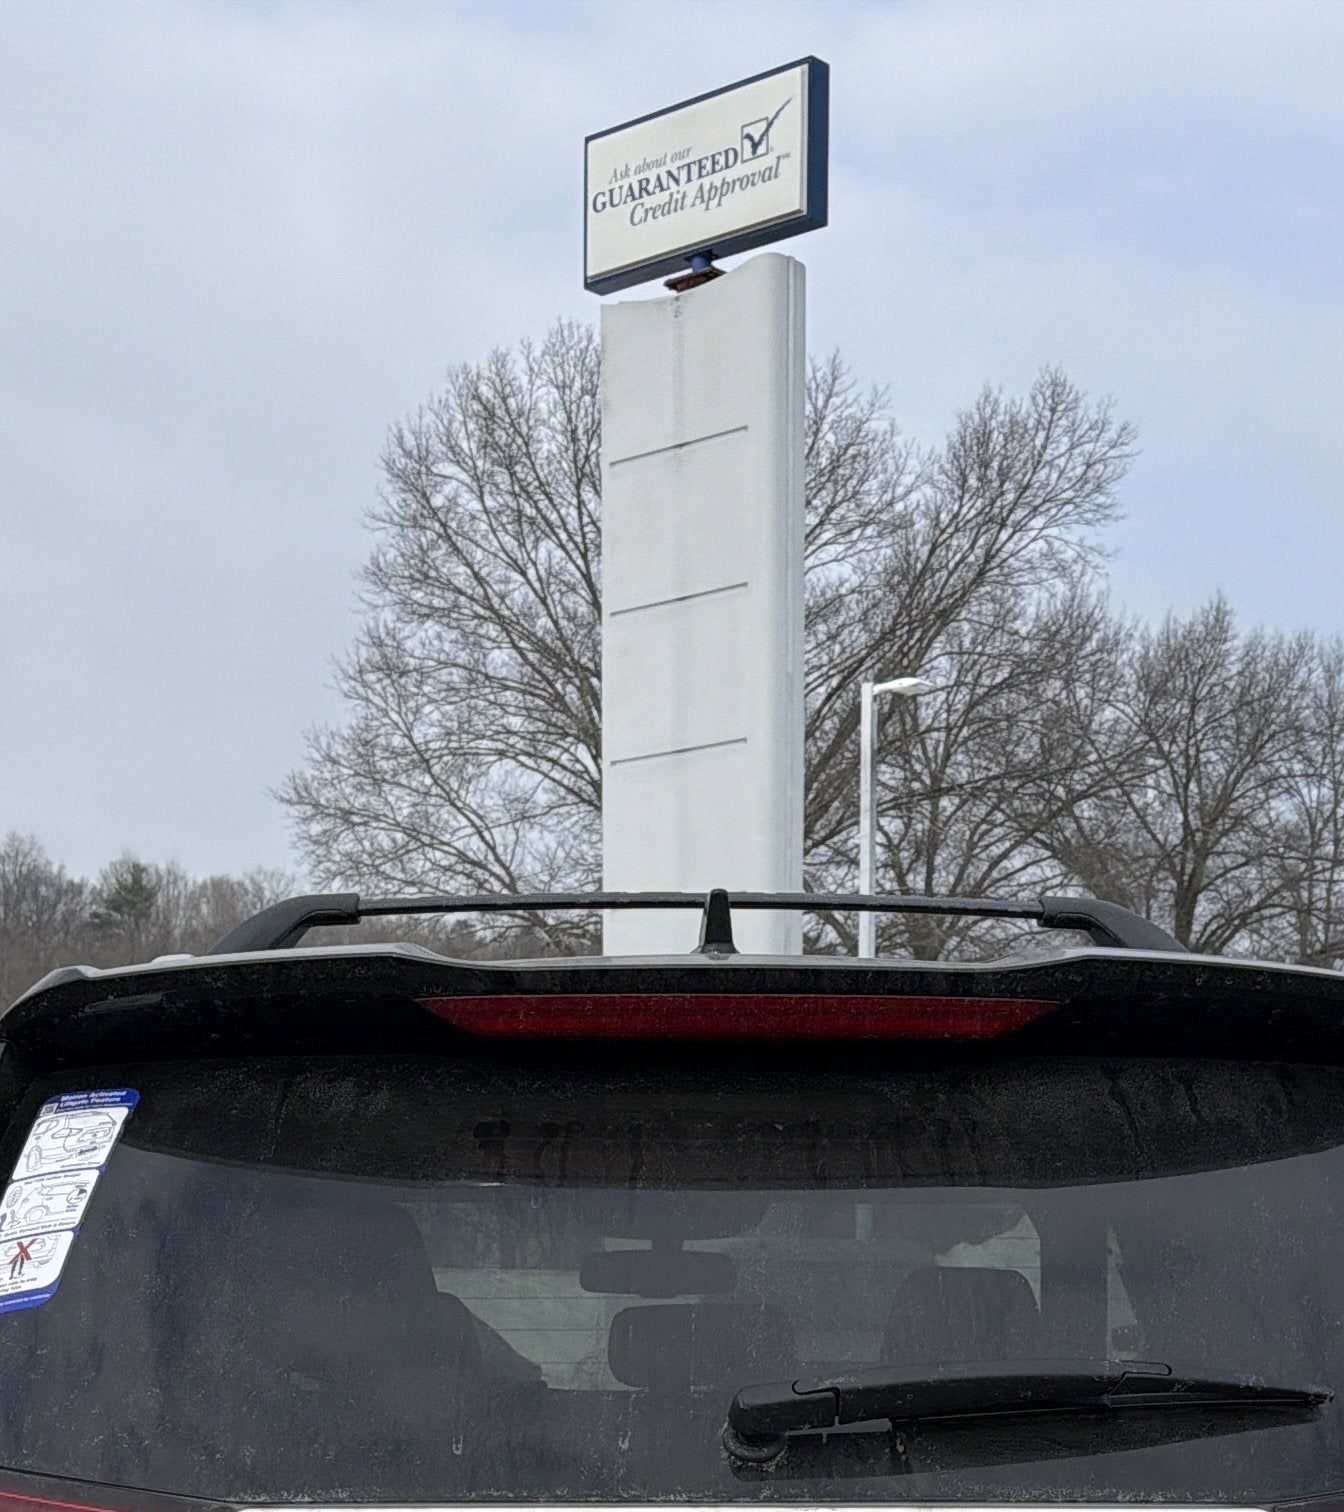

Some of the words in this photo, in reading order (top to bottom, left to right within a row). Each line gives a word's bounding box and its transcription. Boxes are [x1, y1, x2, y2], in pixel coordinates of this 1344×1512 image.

[592, 147, 739, 213] GUARANTEED
[609, 164, 631, 184] Ask
[633, 152, 667, 175] about
[670, 146, 692, 163] our
[629, 189, 687, 226] Credit
[690, 155, 781, 211] Approval
